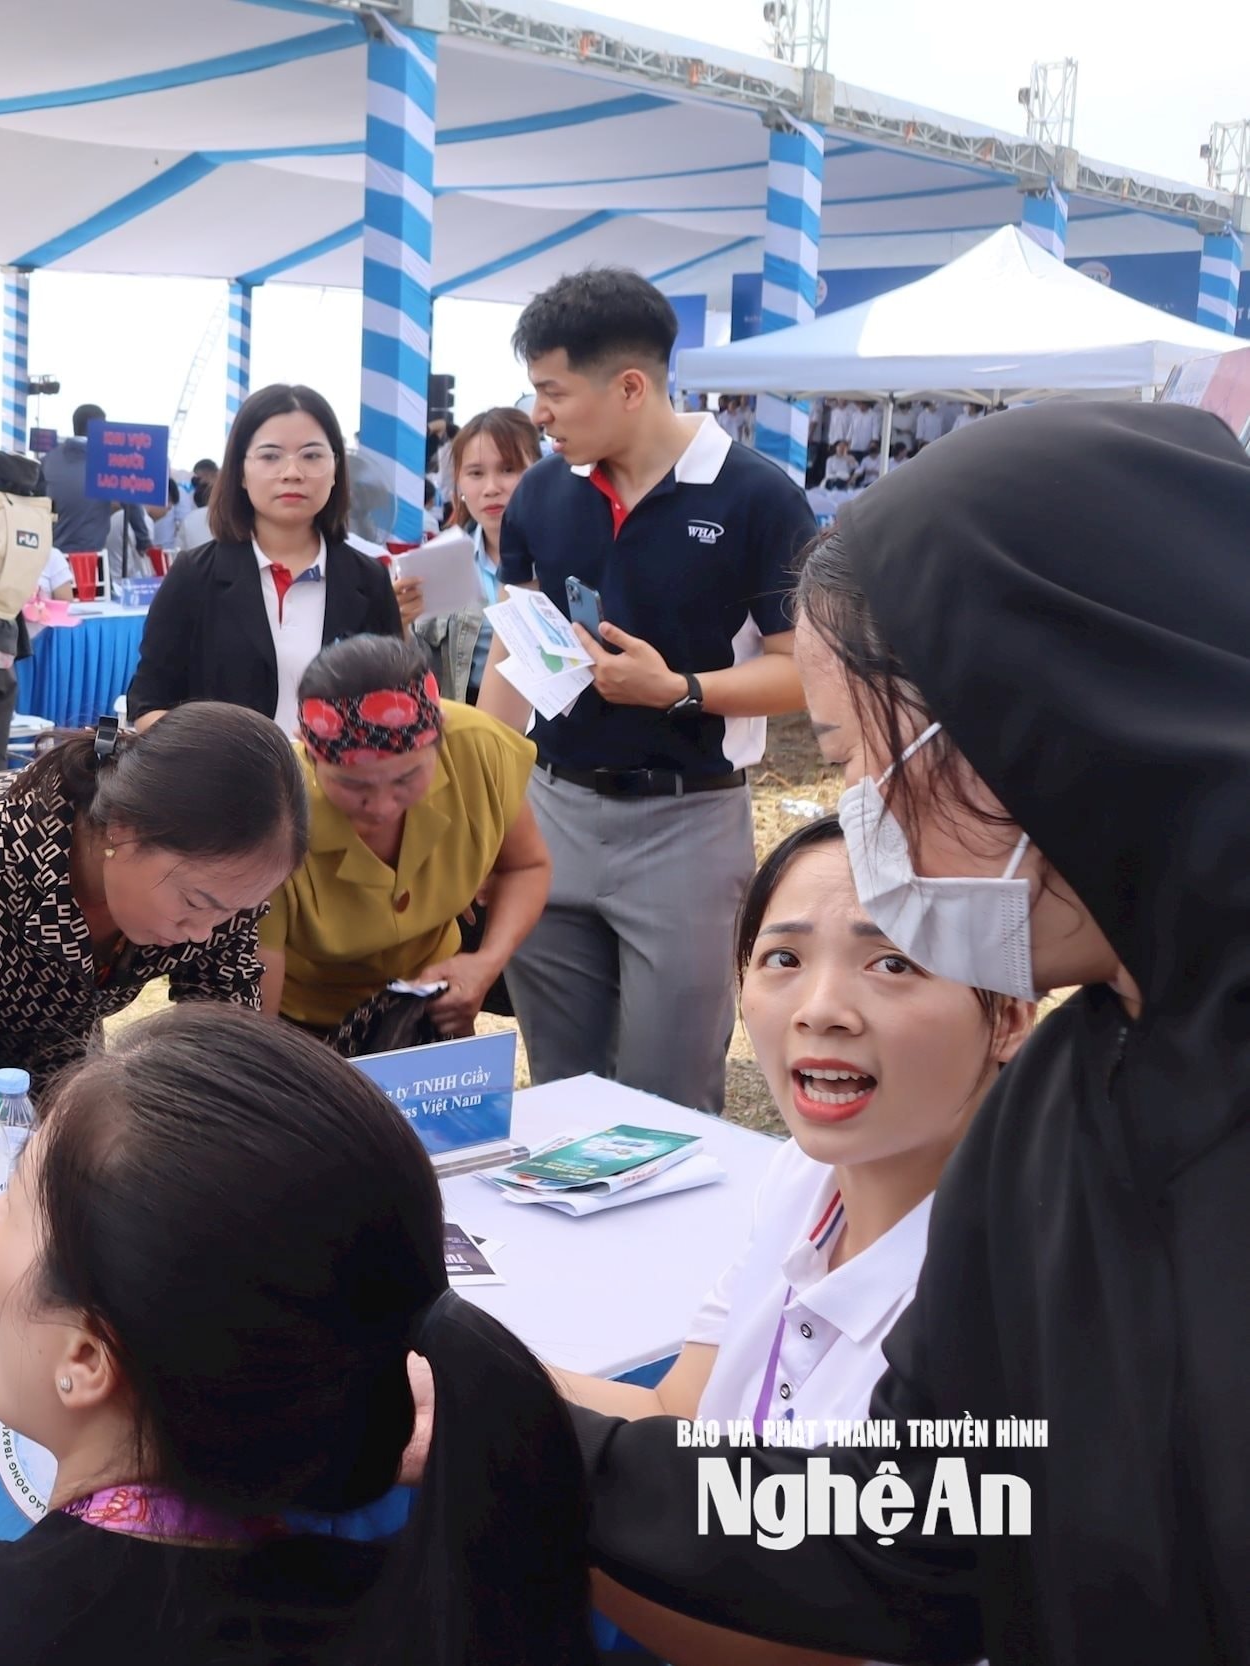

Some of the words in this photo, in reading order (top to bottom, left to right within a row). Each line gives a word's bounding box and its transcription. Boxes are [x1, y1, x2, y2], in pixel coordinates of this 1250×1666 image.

[97, 472, 119, 489] LAO
[19, 533, 37, 546] FILA
[688, 525, 716, 540] WHA
[396, 1086, 410, 1102] ty
[413, 1074, 458, 1096] TNHH
[421, 1097, 448, 1116] Việt
[451, 1093, 482, 1110] Nam
[8, 1461, 30, 1495] ĐỘNG
[28, 1494, 47, 1514] LAO
